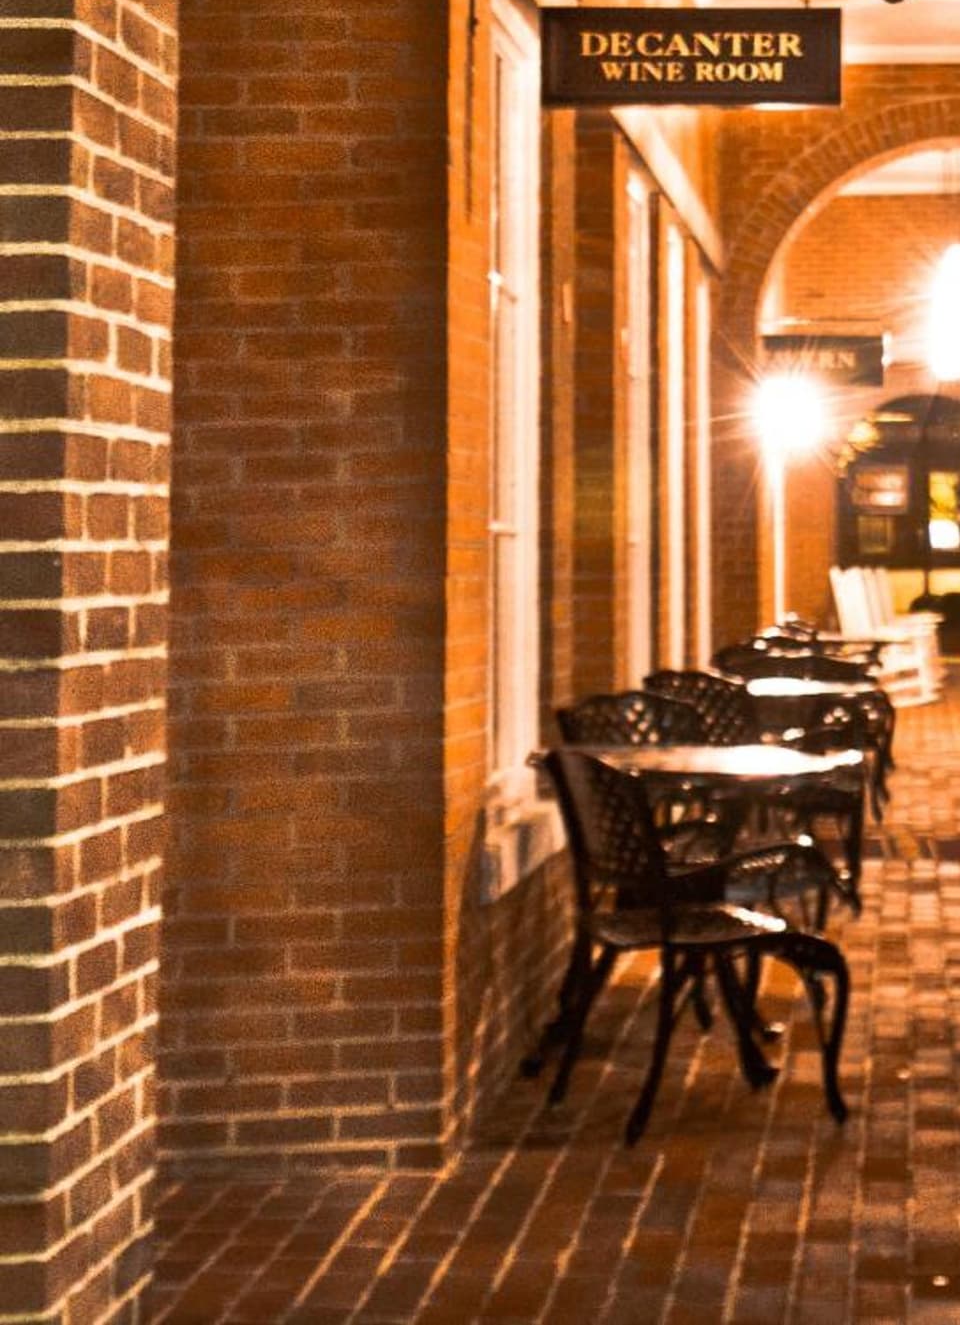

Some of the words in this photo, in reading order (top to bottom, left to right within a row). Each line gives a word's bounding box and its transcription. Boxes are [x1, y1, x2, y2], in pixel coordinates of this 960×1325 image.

[580, 32, 803, 57] DECANTER
[601, 62, 684, 82] WINE
[695, 62, 784, 82] ROOM
